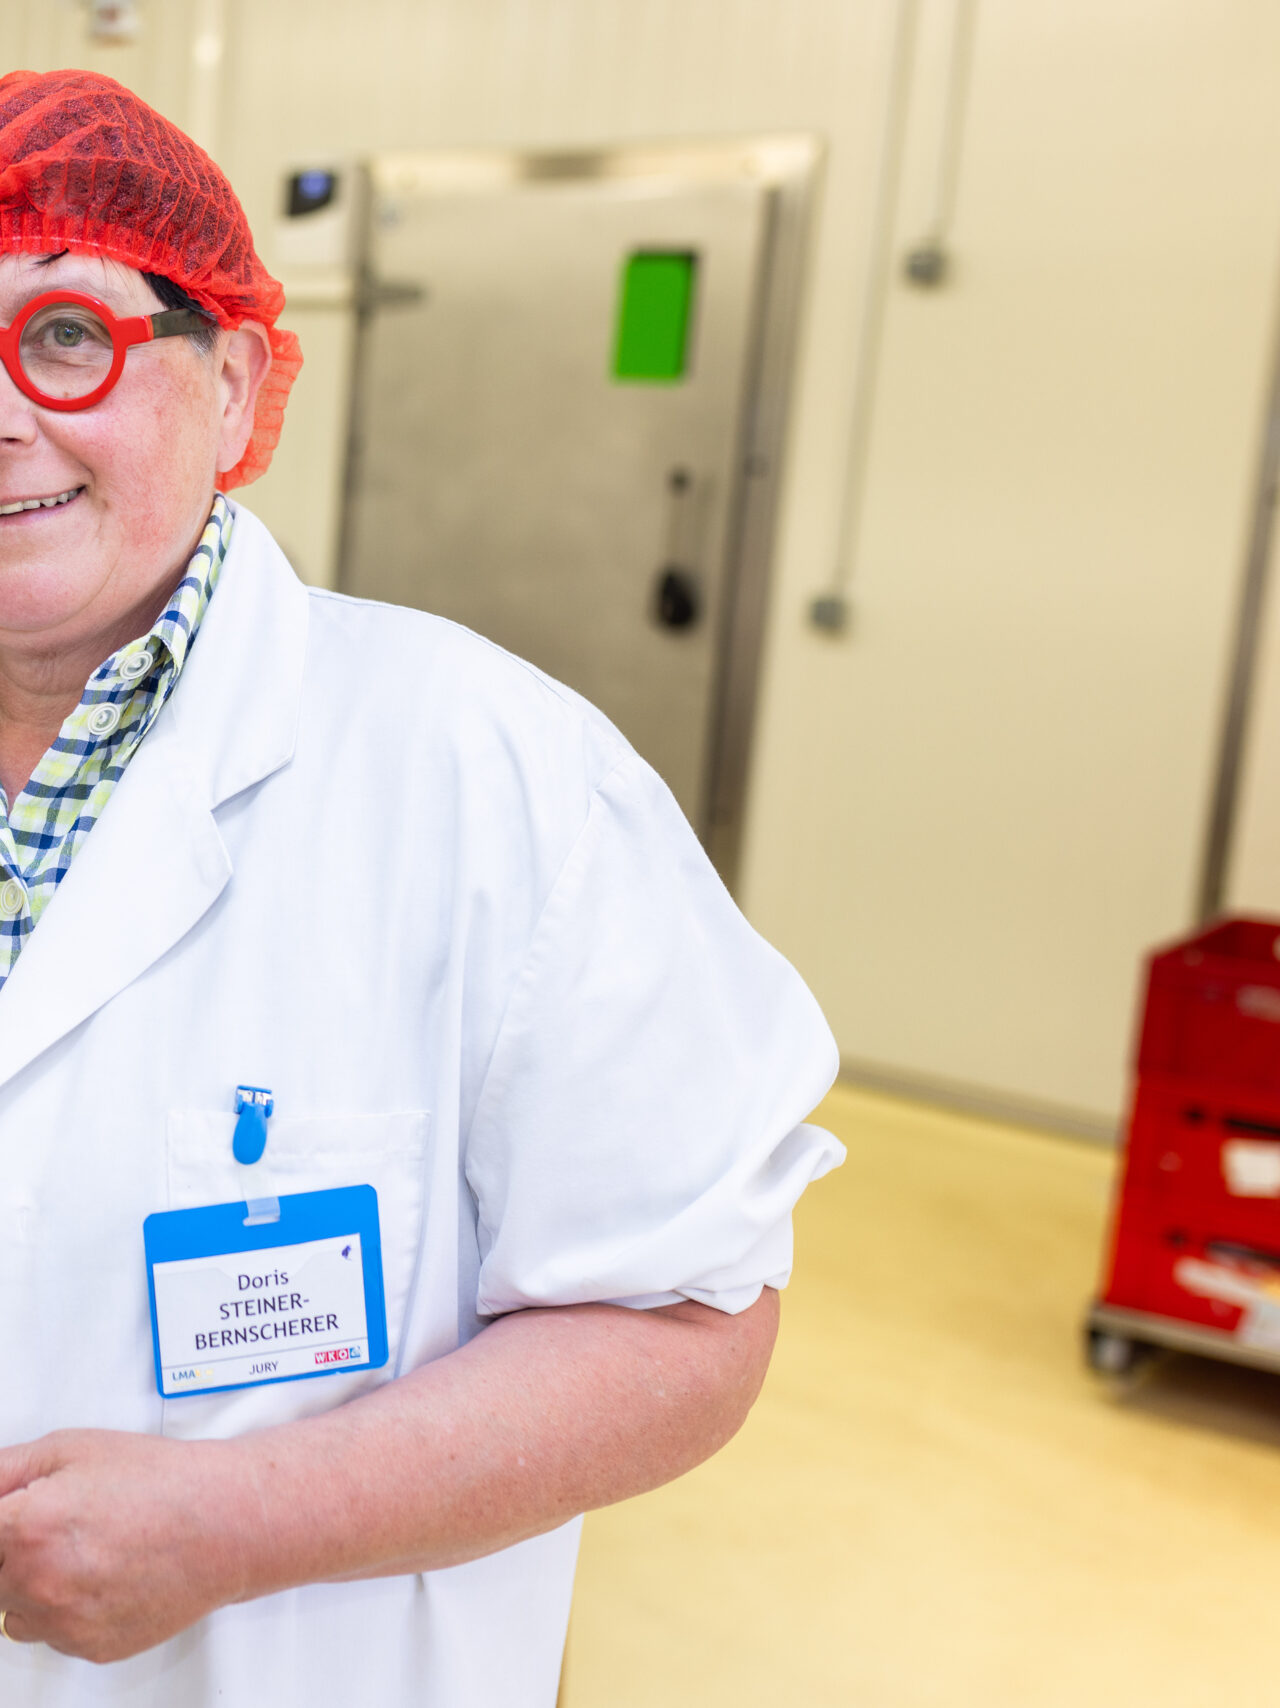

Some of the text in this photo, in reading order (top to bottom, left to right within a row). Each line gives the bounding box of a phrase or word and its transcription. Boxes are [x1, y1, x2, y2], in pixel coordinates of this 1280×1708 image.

[237, 1269, 289, 1291] Doris
[219, 1292, 310, 1320] STEINER-
[195, 1313, 339, 1350] BERNSCHERER
[249, 1361, 279, 1375] JURY
